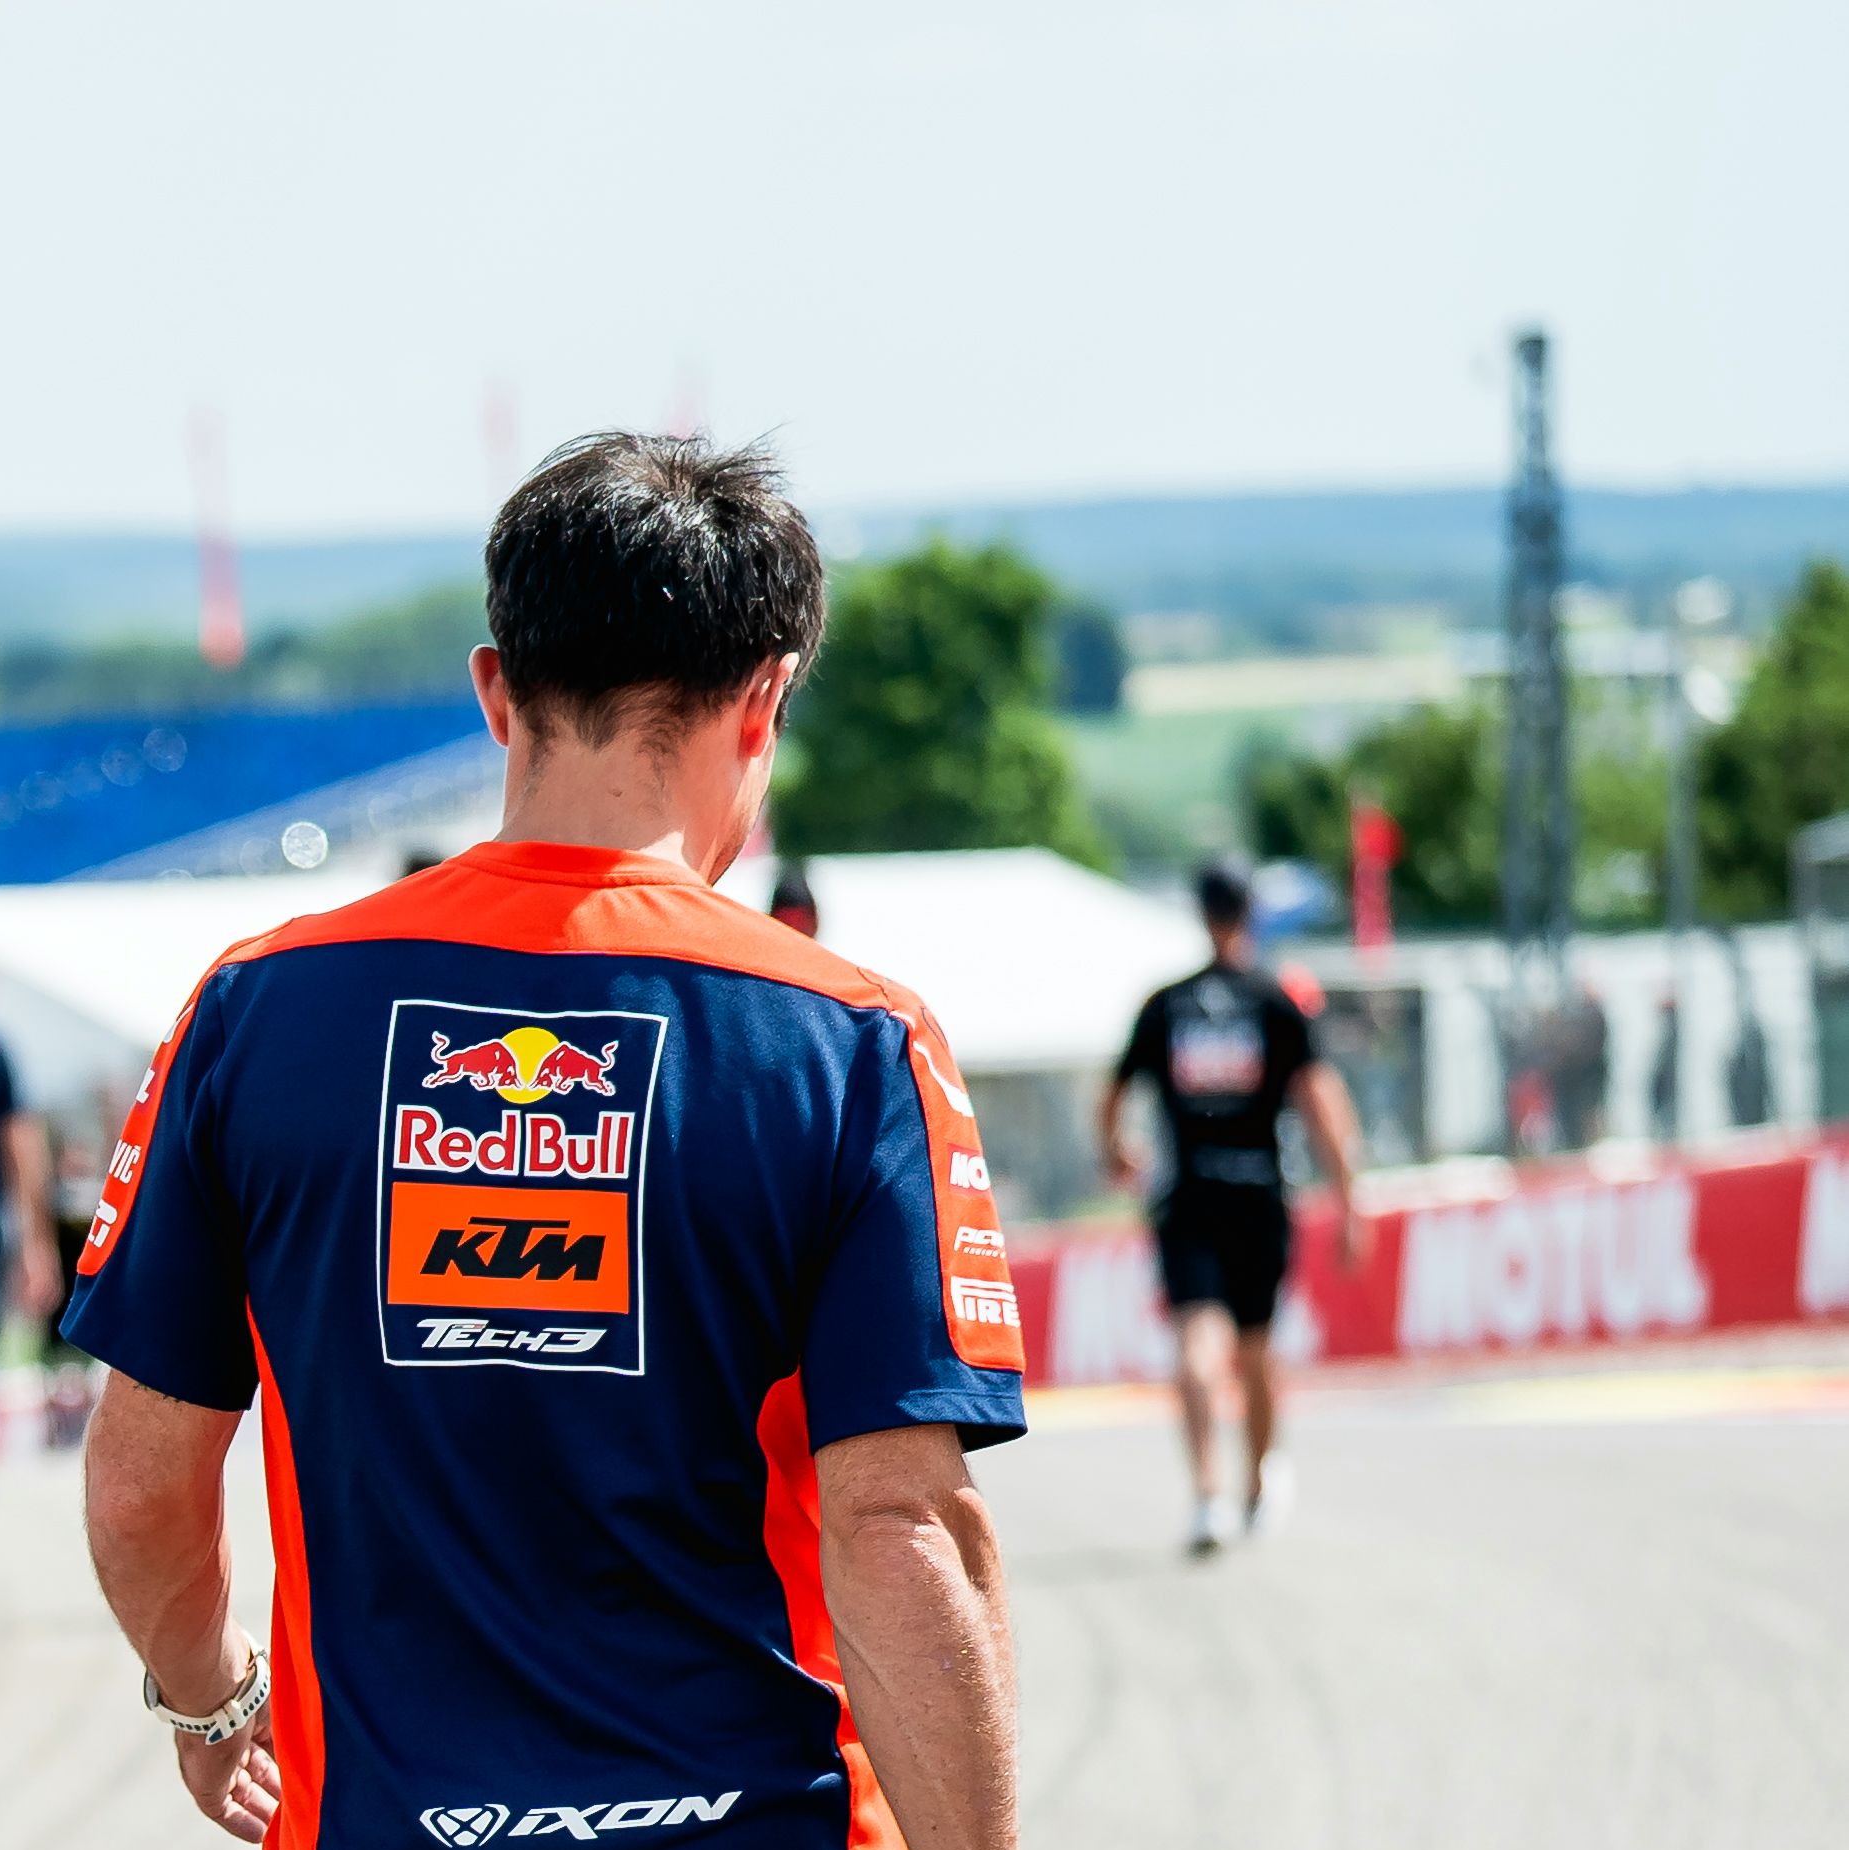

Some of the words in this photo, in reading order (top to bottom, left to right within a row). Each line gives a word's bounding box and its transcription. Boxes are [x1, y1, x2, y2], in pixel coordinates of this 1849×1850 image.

[395, 1106, 519, 1174] Red
[525, 1113, 633, 1177] Bull
[419, 1216, 607, 1281] KTM
[1397, 1174, 1708, 1350] MOTUL
